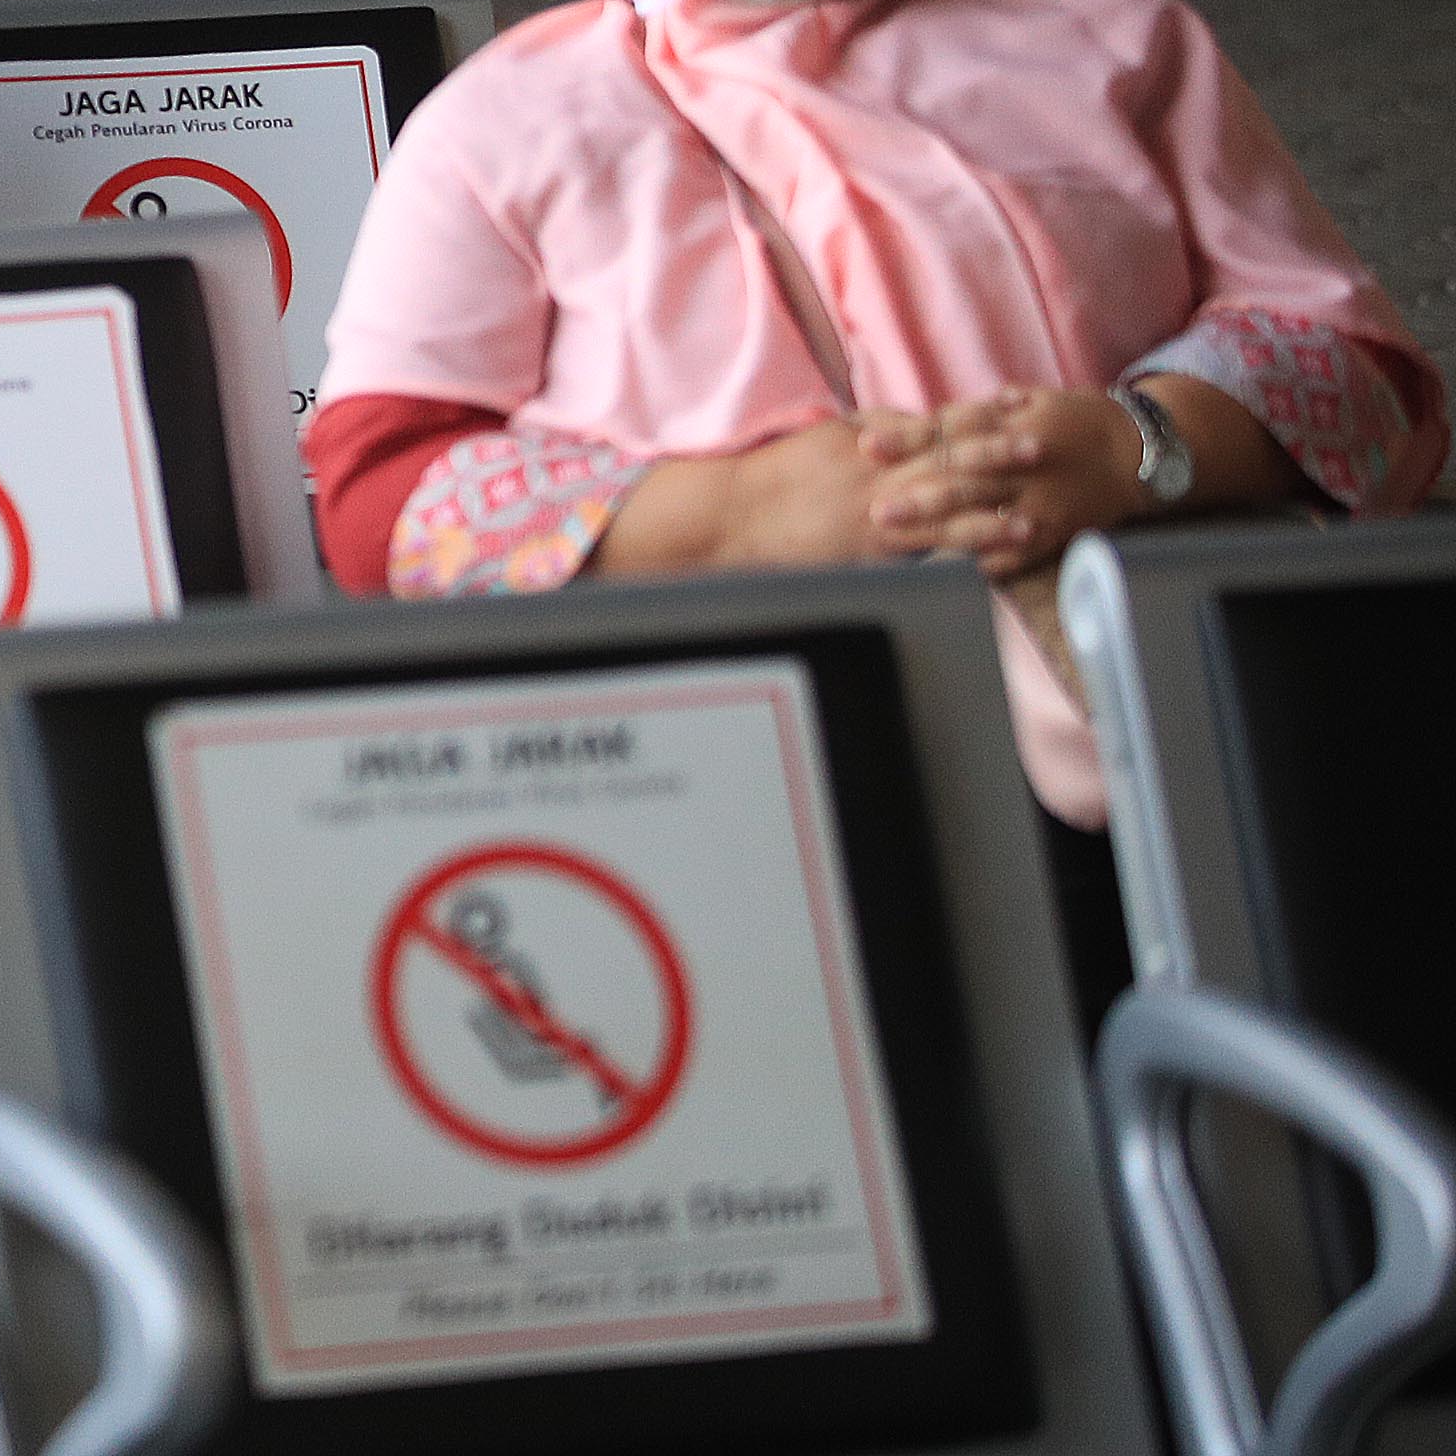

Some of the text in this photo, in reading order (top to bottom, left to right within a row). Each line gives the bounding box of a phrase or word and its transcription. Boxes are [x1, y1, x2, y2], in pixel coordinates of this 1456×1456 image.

[59, 82, 263, 116] JAGA JARAK
[32, 116, 293, 143] Cegah Penularan Virus Corona
